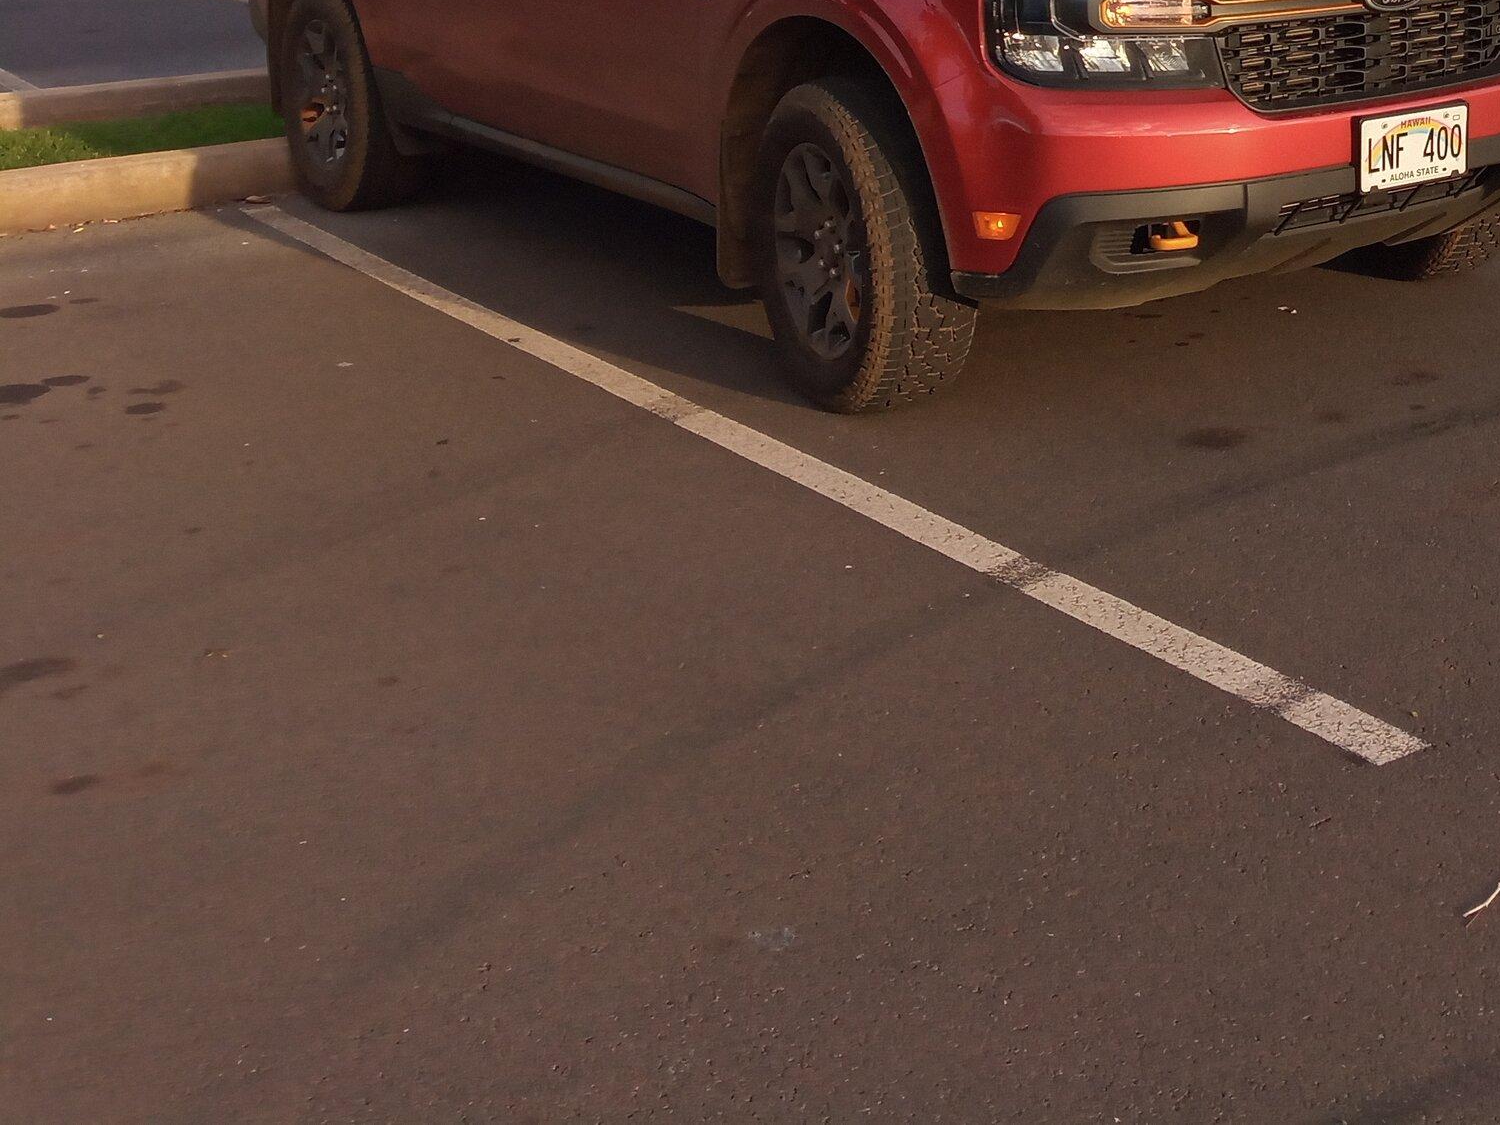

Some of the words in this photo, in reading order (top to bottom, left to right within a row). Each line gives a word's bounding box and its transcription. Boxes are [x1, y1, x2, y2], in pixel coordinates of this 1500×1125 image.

[1400, 116, 1432, 130] HAWAII
[1368, 131, 1409, 174] LNF
[1423, 123, 1463, 163] 400
[1389, 170, 1415, 183] ALOHA
[1416, 165, 1440, 178] STATE
